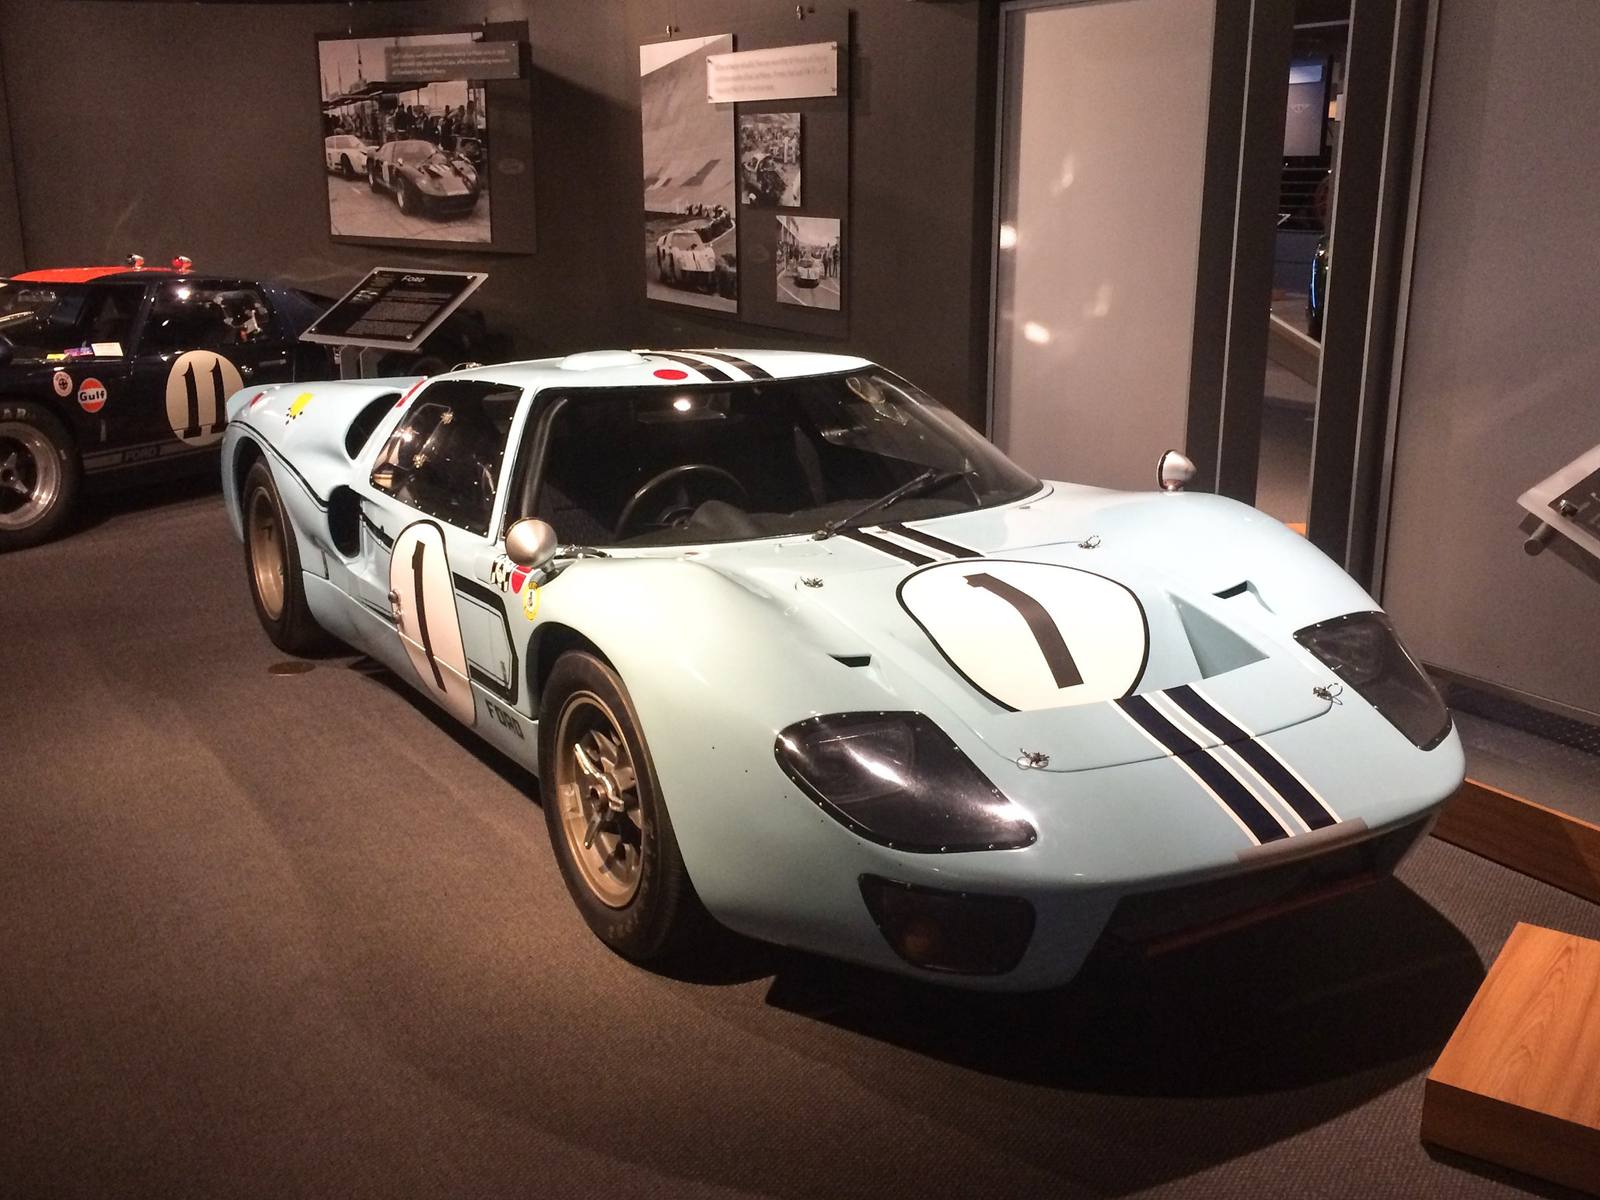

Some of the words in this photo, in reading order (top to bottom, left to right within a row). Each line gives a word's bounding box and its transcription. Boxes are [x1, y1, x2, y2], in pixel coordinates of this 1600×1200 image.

[80, 390, 105, 401] Gulf
[182, 357, 229, 439] 11
[411, 540, 448, 693] 1
[962, 572, 1084, 689] 1
[485, 698, 525, 740] FORD
